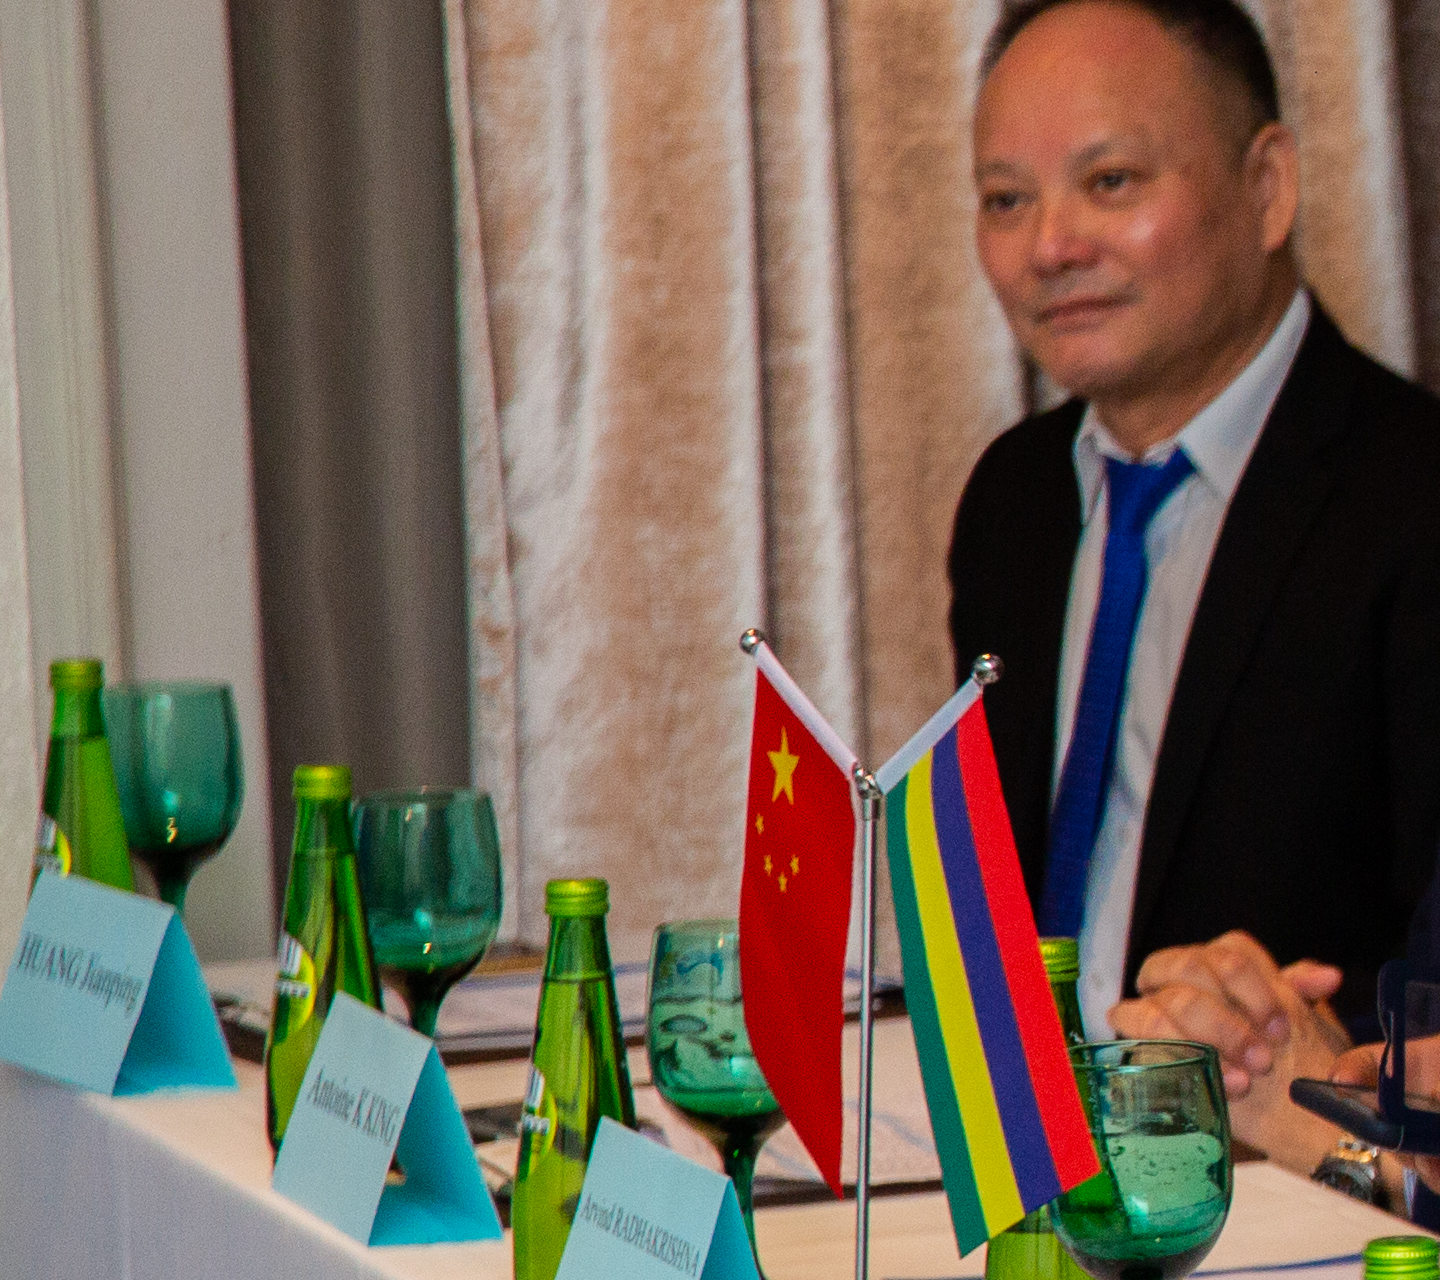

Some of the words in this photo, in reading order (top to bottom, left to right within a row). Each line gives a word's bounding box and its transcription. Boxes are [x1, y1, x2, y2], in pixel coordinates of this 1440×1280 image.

[16, 932, 84, 989] HUANG
[306, 1066, 354, 1122] Antoine
[351, 1087, 368, 1130] K
[362, 1093, 401, 1148] KING
[580, 1194, 617, 1235] Arvind
[611, 1205, 701, 1277] RADHAKRISHNA
